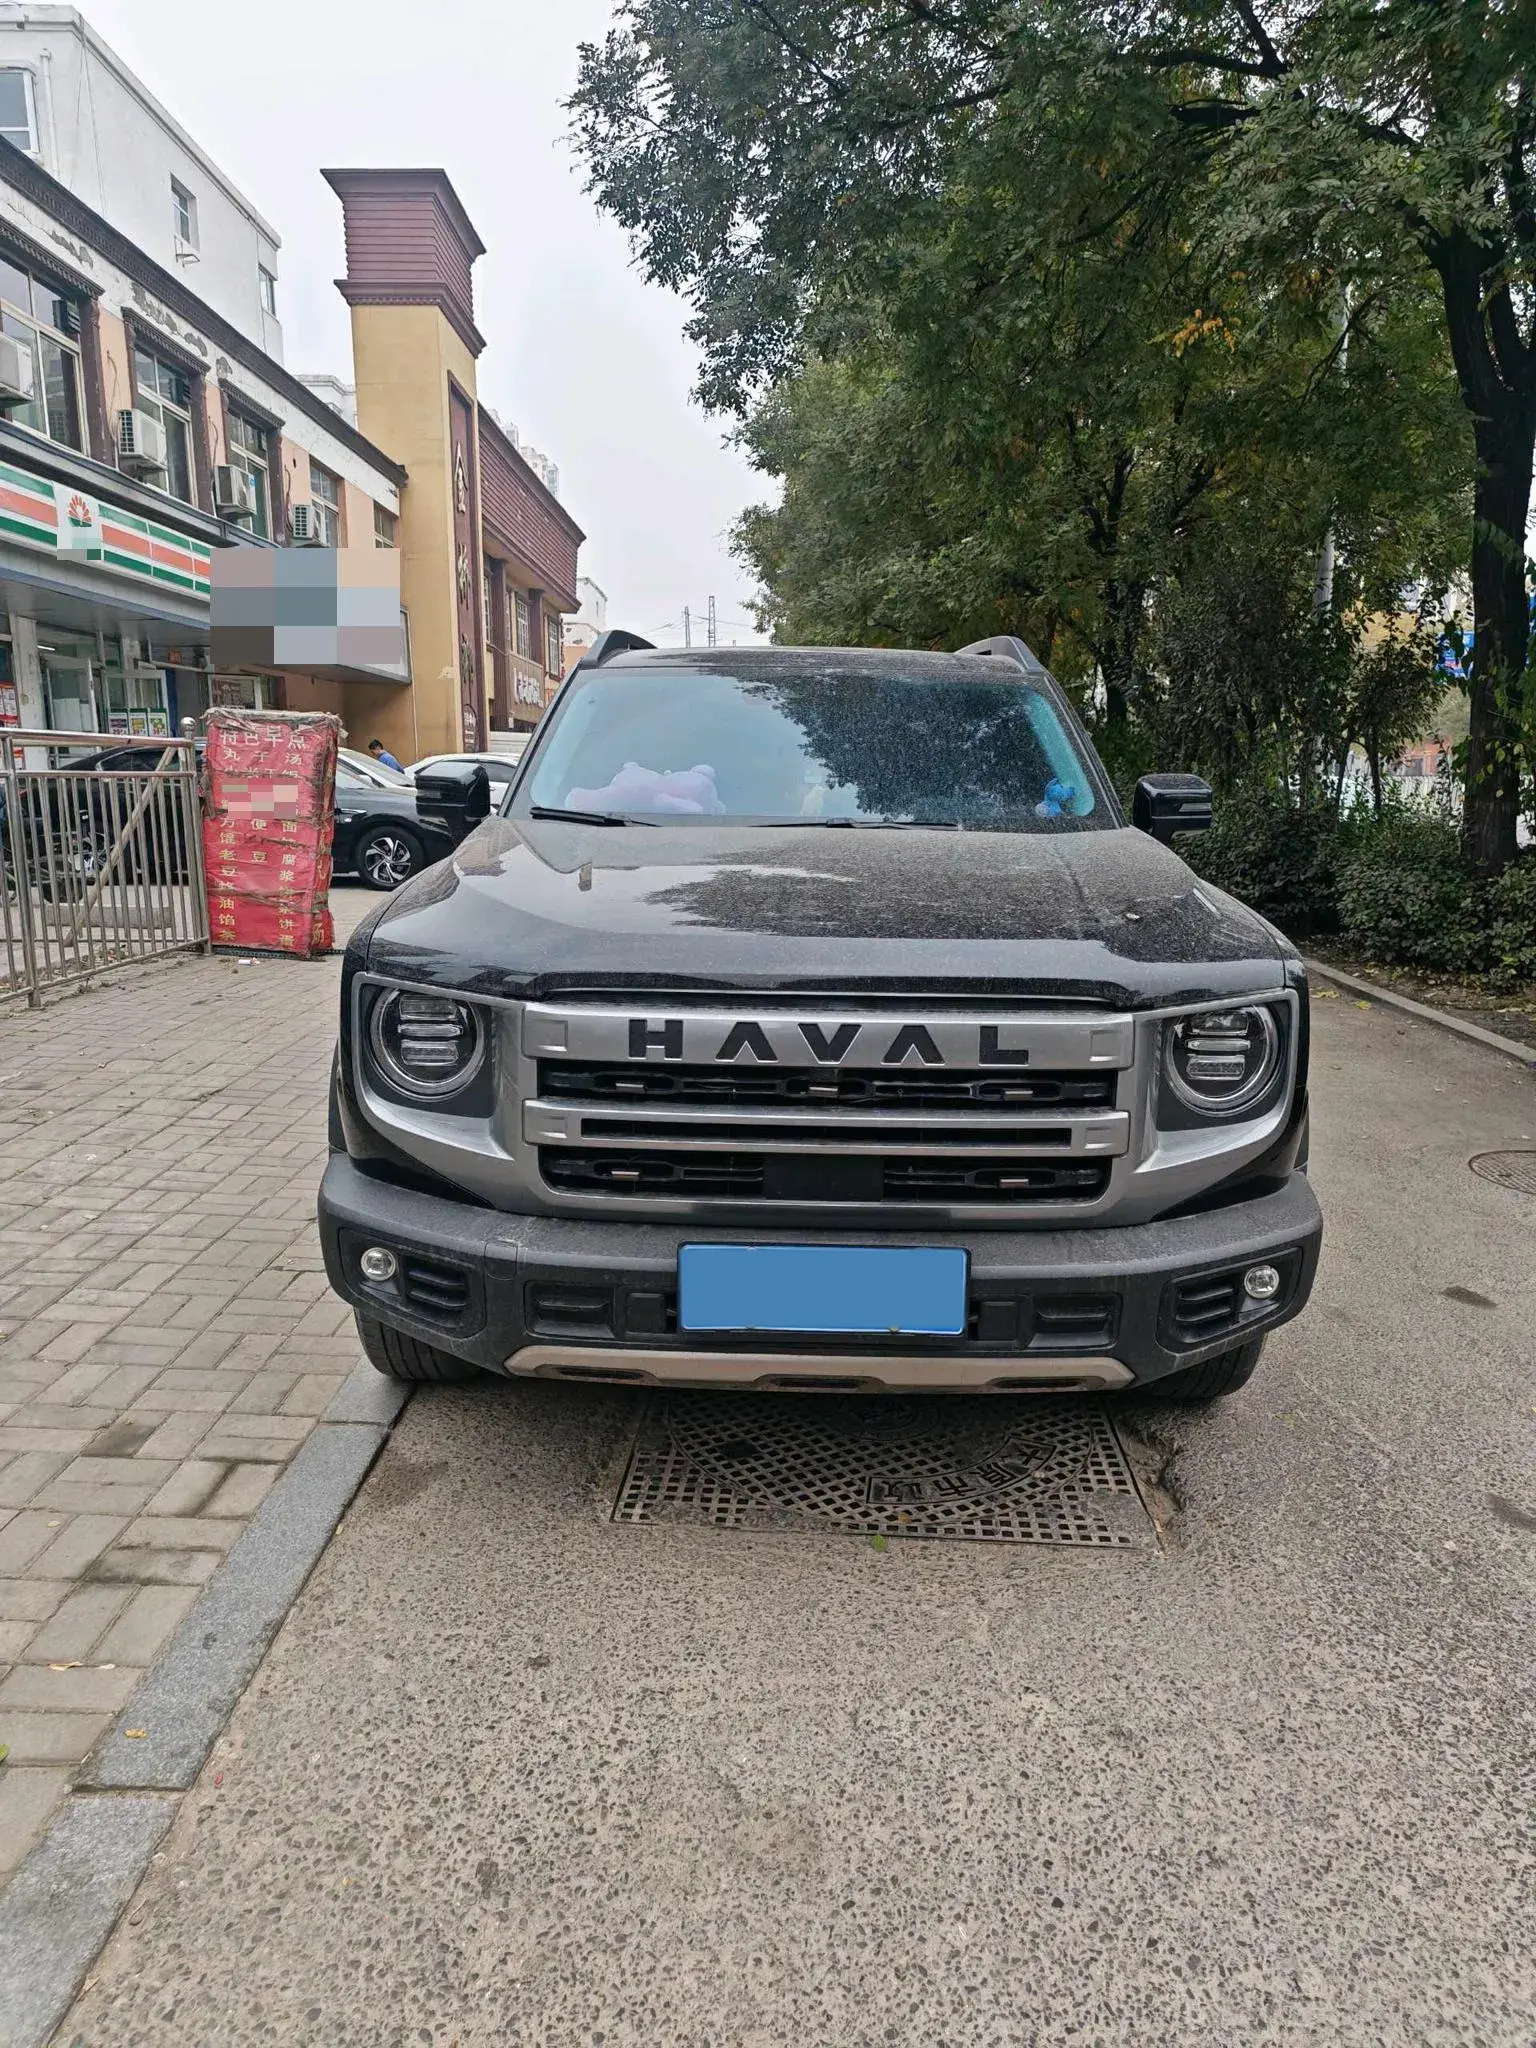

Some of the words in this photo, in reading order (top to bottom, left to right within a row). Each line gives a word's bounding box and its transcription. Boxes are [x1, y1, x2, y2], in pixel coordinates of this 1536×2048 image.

[219, 817, 297, 833] 方便面
[218, 849, 297, 867] 老豆腐
[628, 1018, 1030, 1066] HAVAL
